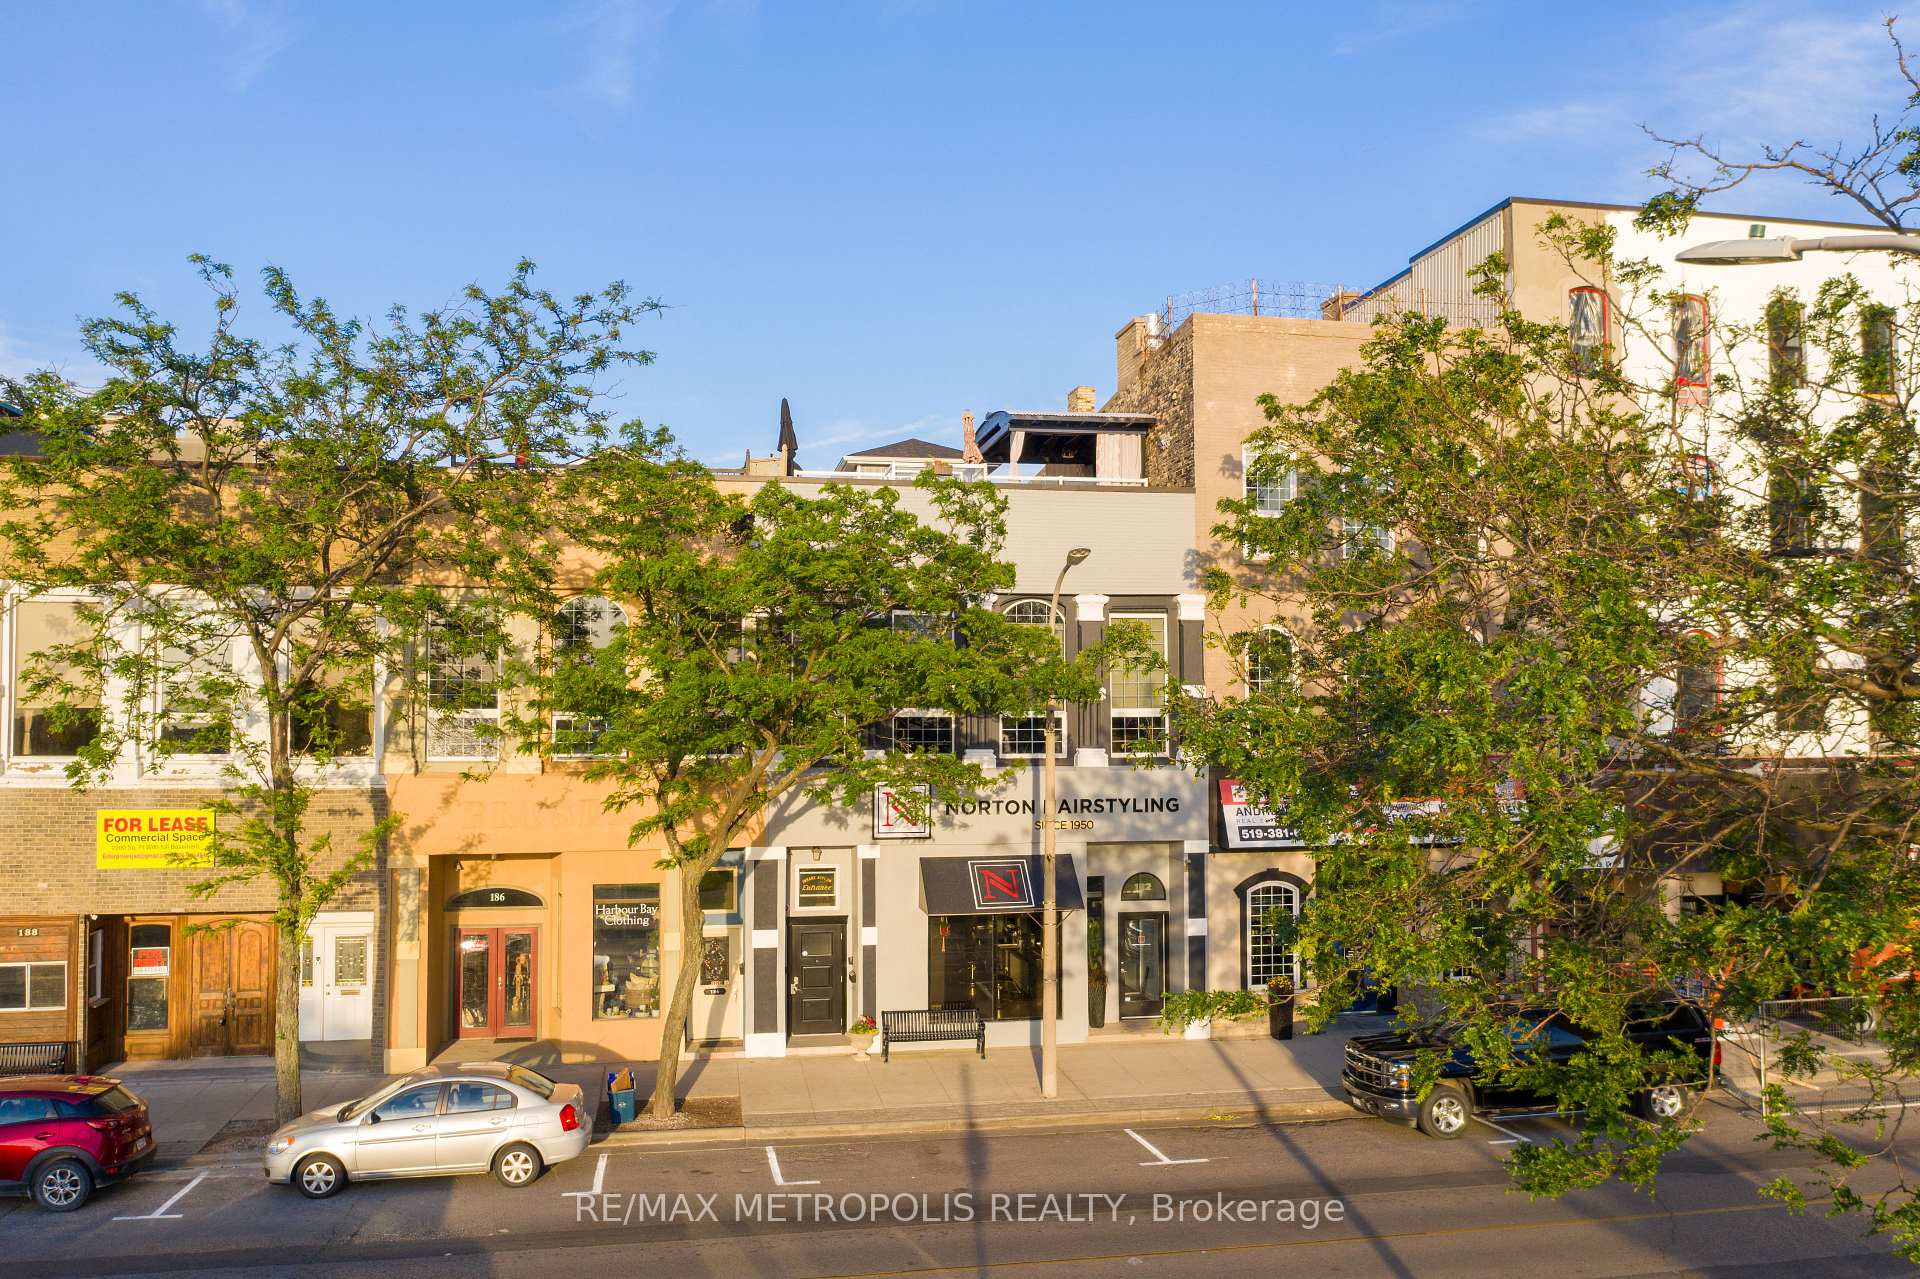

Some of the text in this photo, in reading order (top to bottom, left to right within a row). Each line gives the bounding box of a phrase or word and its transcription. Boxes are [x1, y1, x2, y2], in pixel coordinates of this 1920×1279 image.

[945, 797, 1180, 816] NORTON AIRSTYLING
[103, 816, 208, 832] FOR LEASE
[1034, 820, 1094, 830] SICE 1950
[106, 832, 205, 844] Commercial Space
[979, 869, 1024, 900] N
[490, 893, 505, 902] 186
[595, 903, 658, 916] Harbour Bay
[604, 914, 650, 927] Clothing
[18, 928, 38, 937] 188
